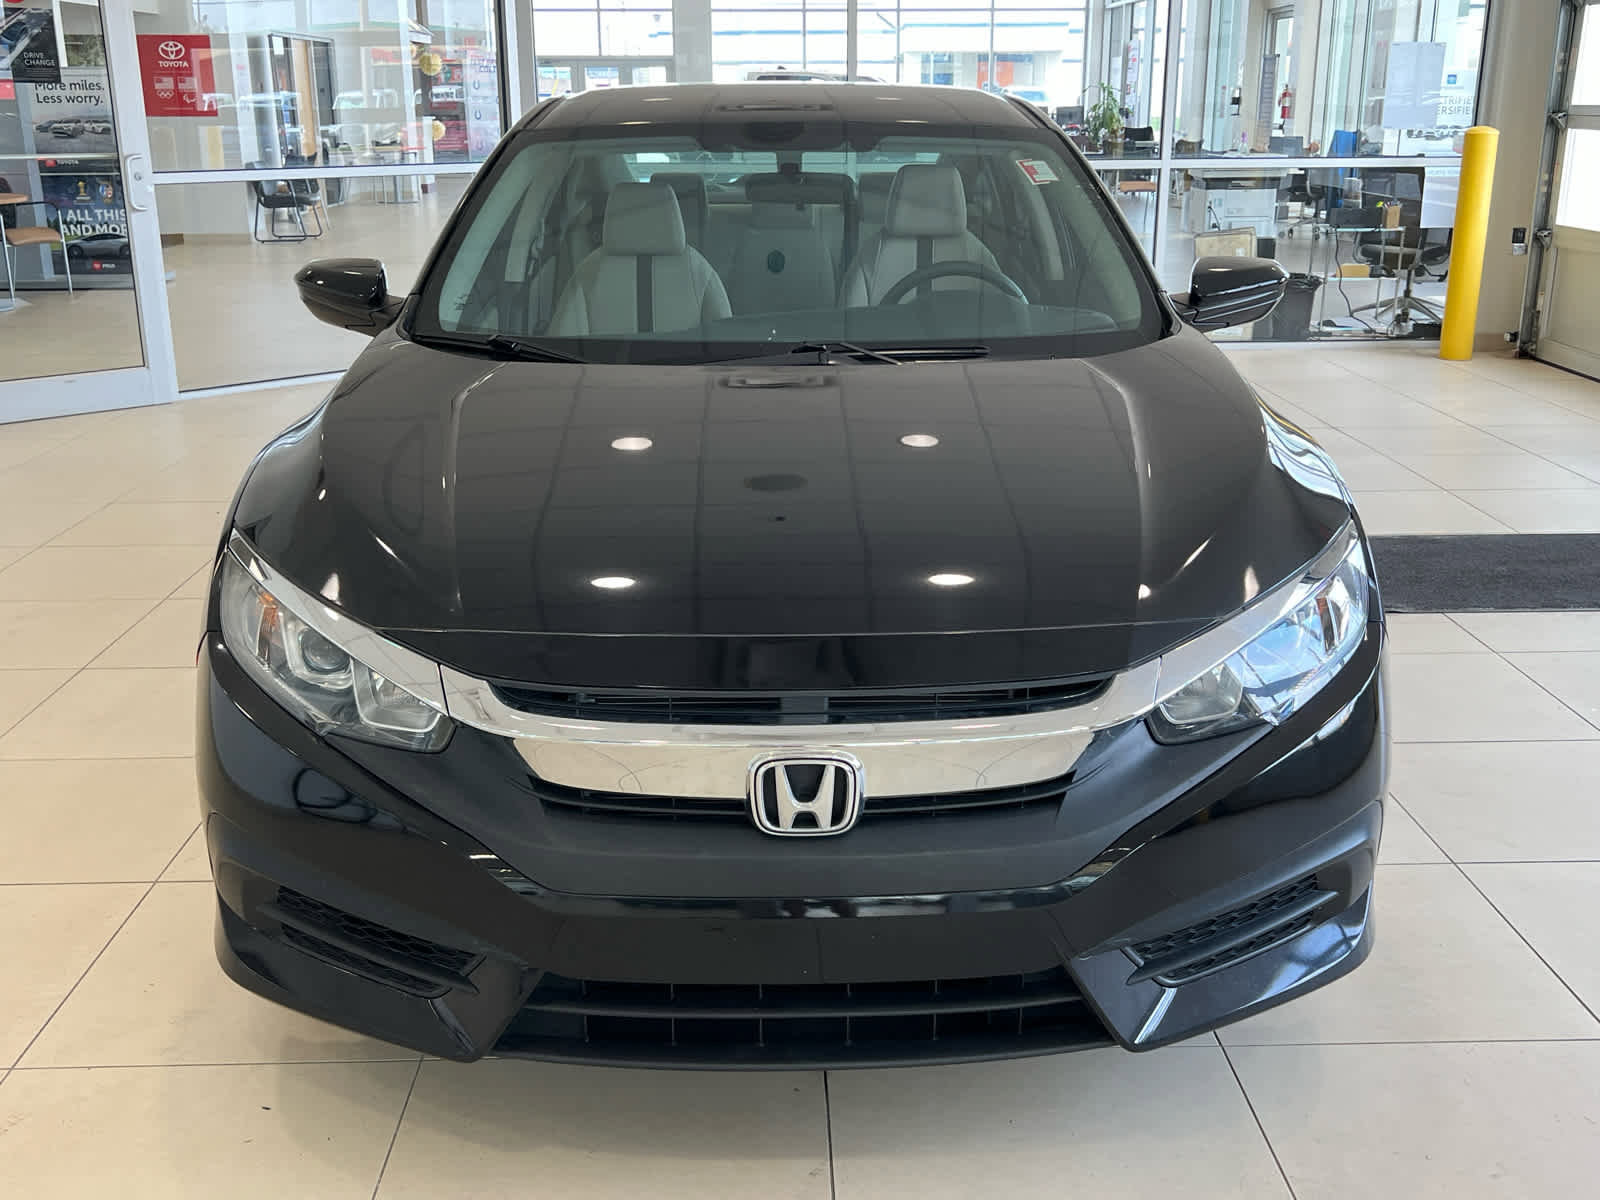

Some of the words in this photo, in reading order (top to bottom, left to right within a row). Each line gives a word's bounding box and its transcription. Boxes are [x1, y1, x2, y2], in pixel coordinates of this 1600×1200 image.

[34, 82, 66, 91] More
[69, 80, 104, 91] miles.
[36, 93, 62, 104] Less
[65, 95, 103, 106] worry.
[67, 209, 93, 222] ALL
[95, 209, 126, 222] THIS
[62, 224, 92, 236] AND
